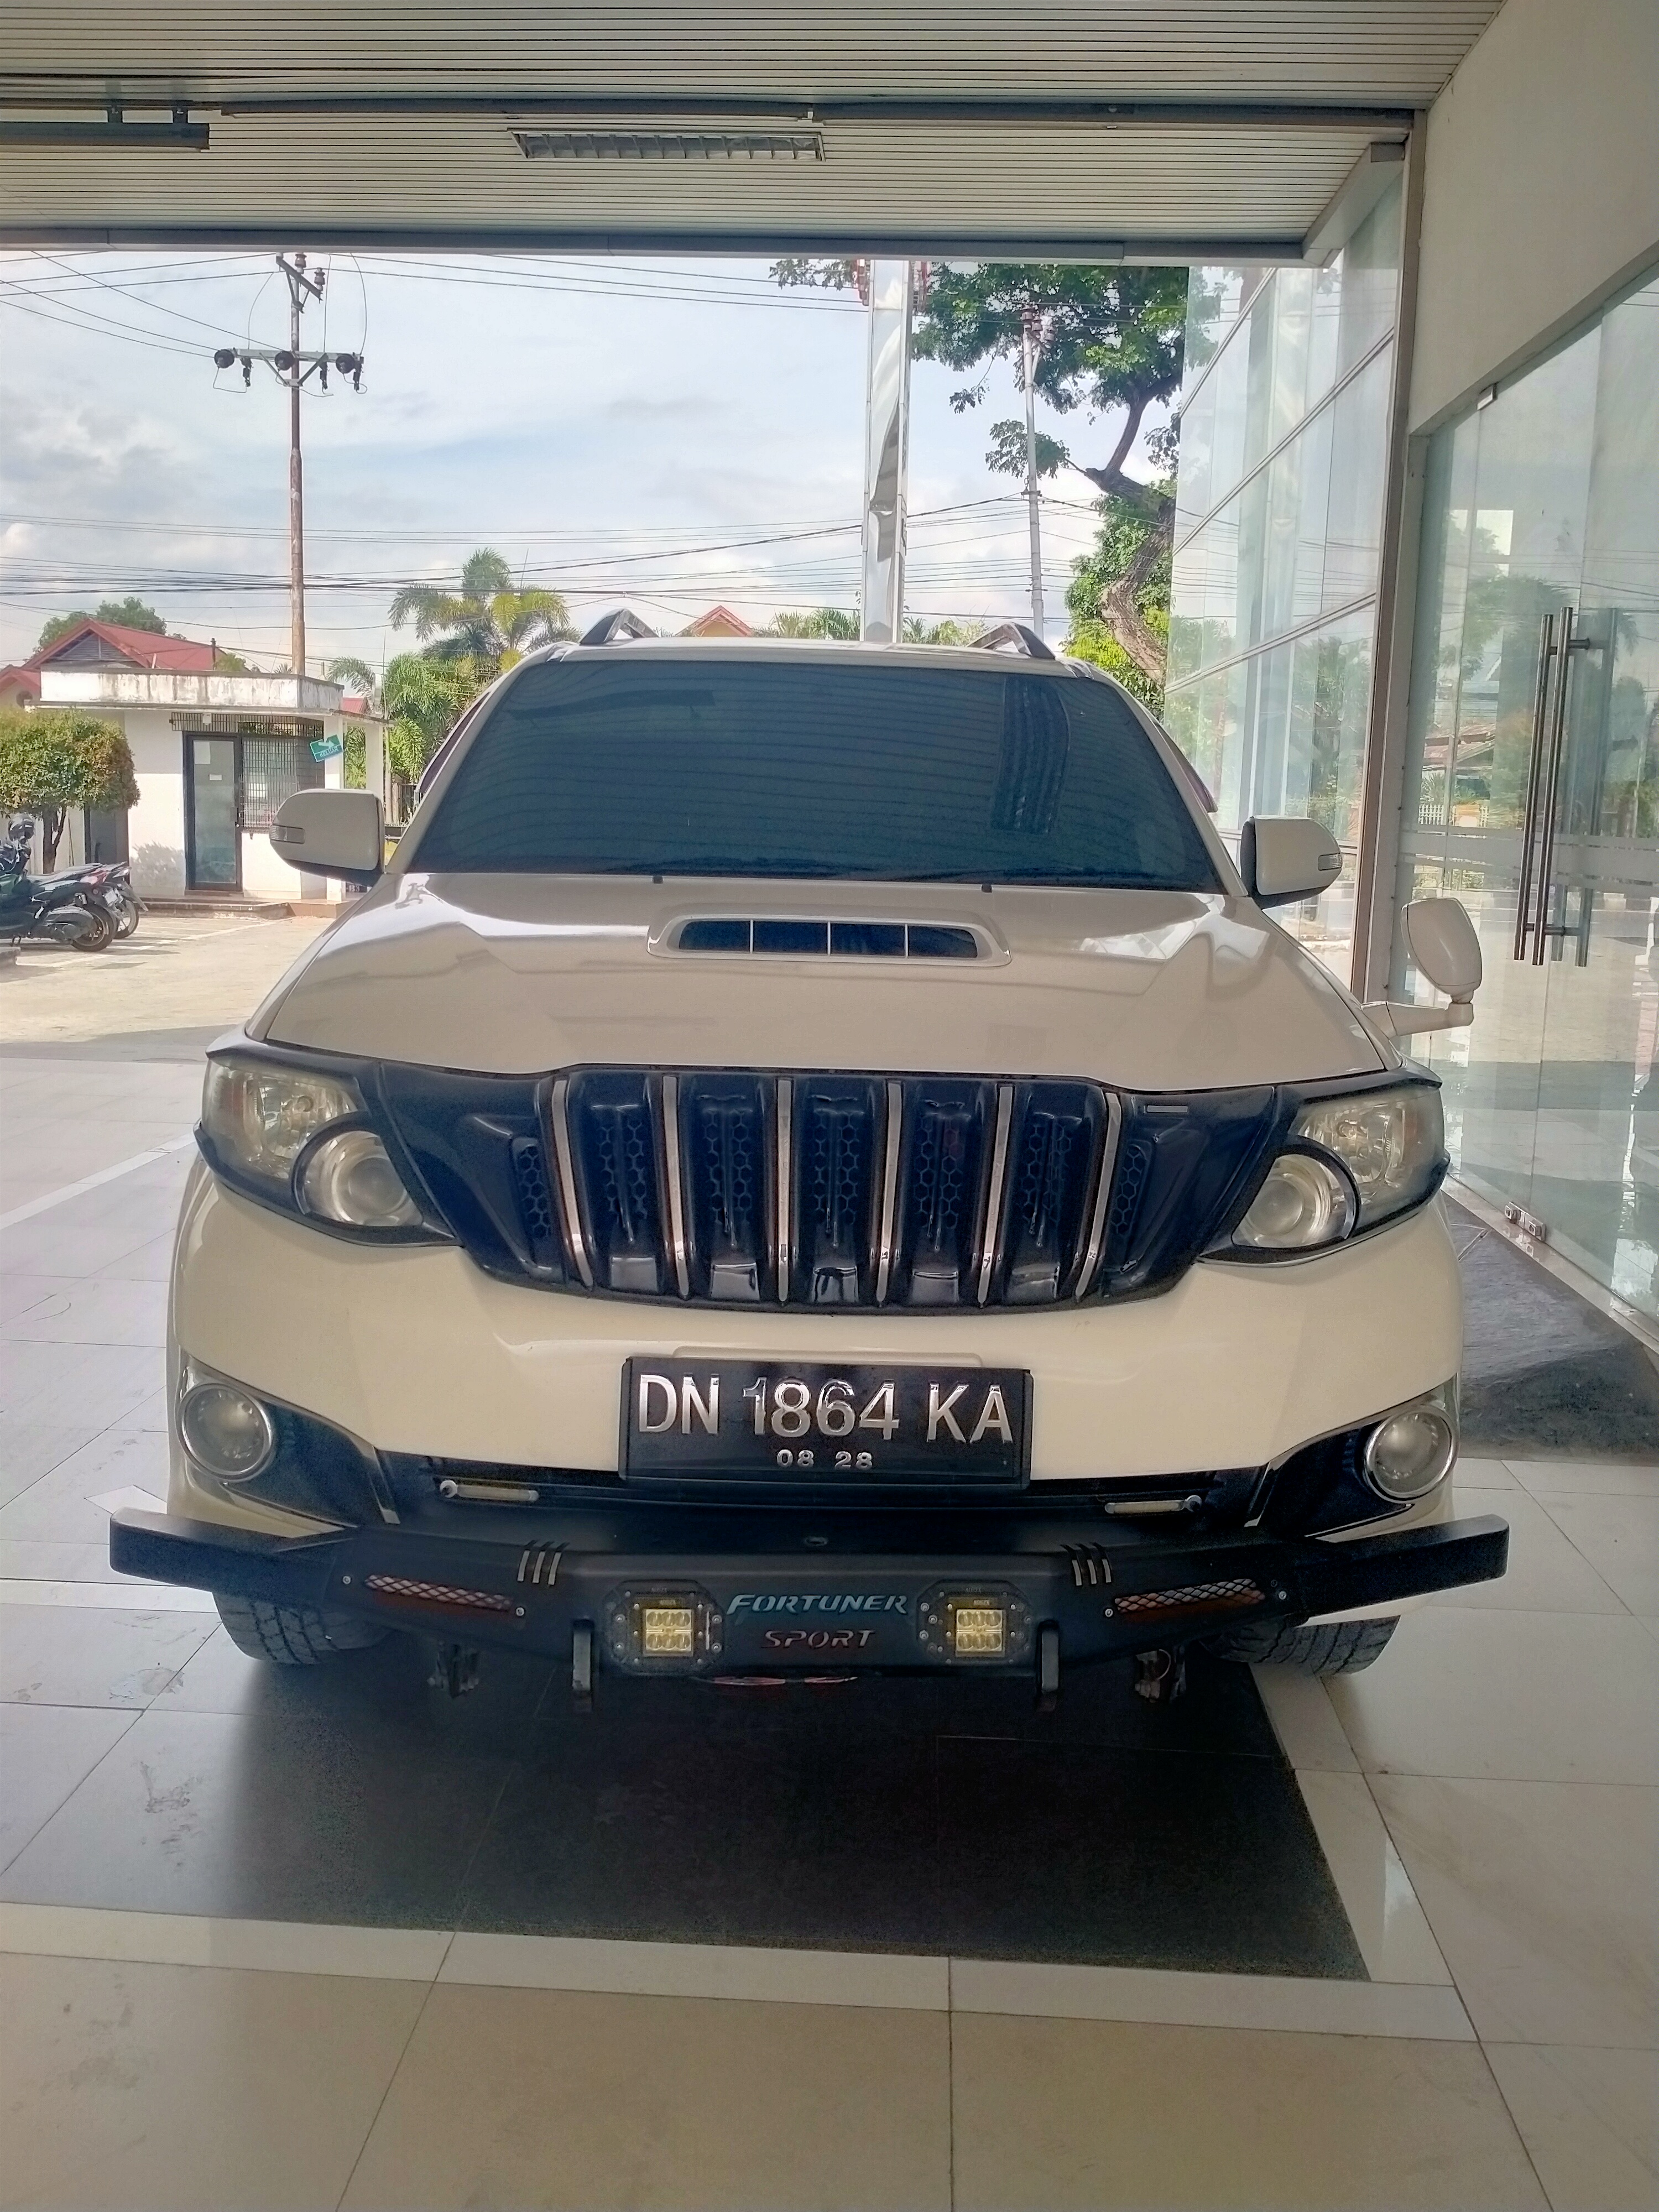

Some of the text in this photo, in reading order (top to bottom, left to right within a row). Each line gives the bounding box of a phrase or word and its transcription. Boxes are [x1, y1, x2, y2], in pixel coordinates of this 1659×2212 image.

[319, 747, 339, 758] KELUAR
[639, 1374, 1014, 1444] DN 1864 KA
[776, 1449, 874, 1469] 08 28
[727, 1593, 908, 1615] FORTUNER
[761, 1630, 875, 1649] SPORT
